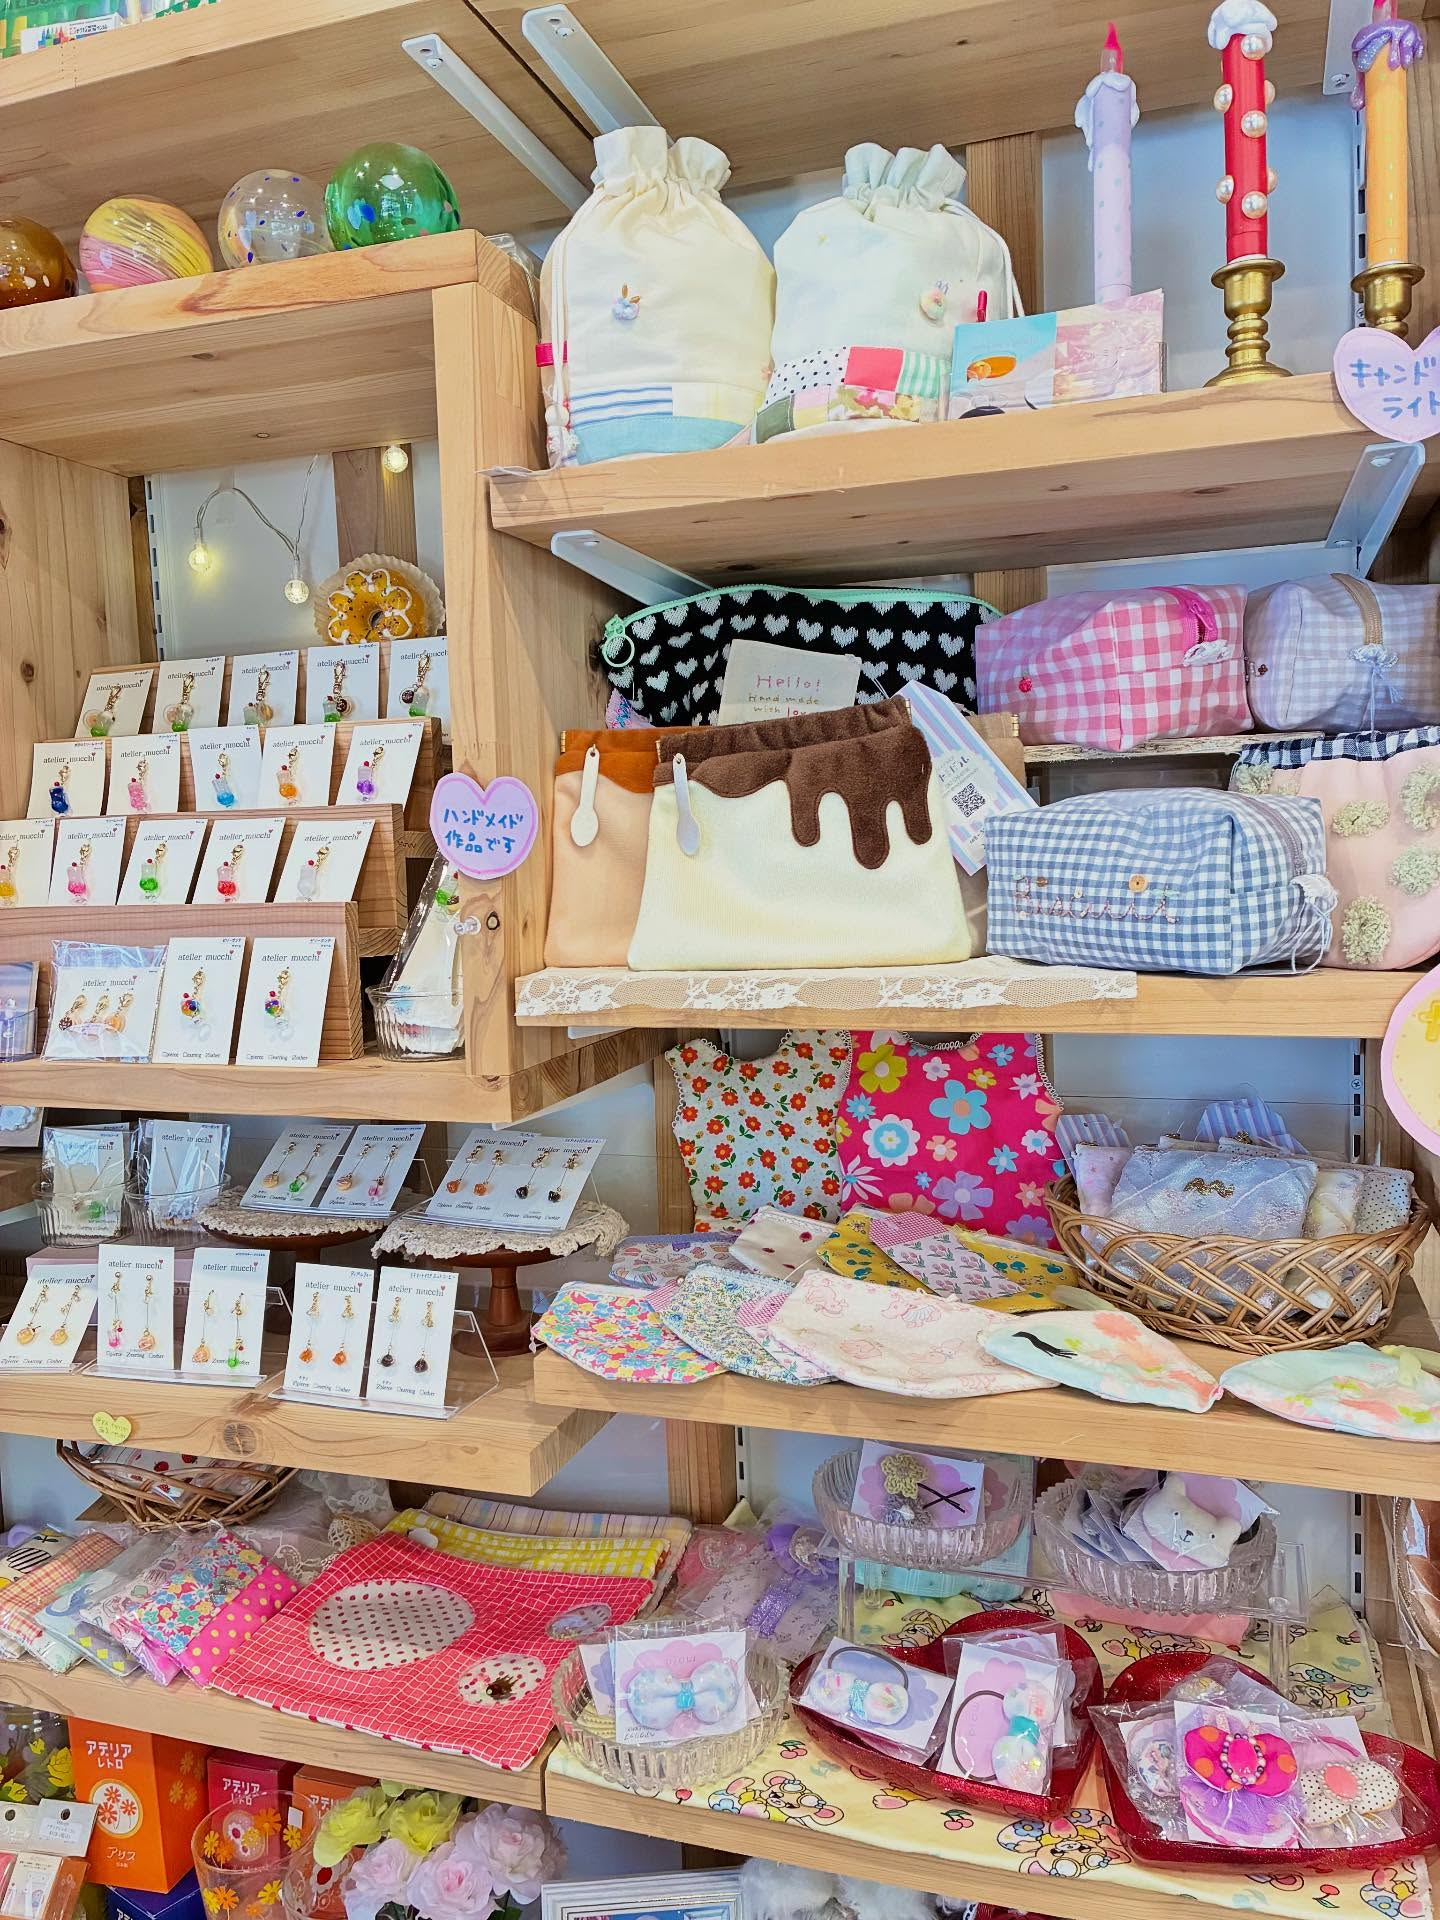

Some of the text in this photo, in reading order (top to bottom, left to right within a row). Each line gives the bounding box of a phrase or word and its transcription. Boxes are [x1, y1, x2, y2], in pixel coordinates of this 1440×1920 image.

[756, 674, 820, 693] Hello!
[444, 808, 523, 829] ハンドメイド
[0, 832, 16, 841] telier
[444, 829, 516, 854] 作品です
[177, 952, 232, 961] atelier mucchi
[261, 953, 320, 962] atelier mucchi
[109, 1260, 162, 1270] atelier mucchi
[203, 1263, 256, 1272] atelier mucchi
[37, 1276, 93, 1285] atelier mucchi
[305, 1281, 361, 1294] atelier mucchi
[388, 1285, 444, 1297] atelier mucchi
[97, 1757, 124, 1769] レトロ
[106, 1846, 136, 1861] アリス
